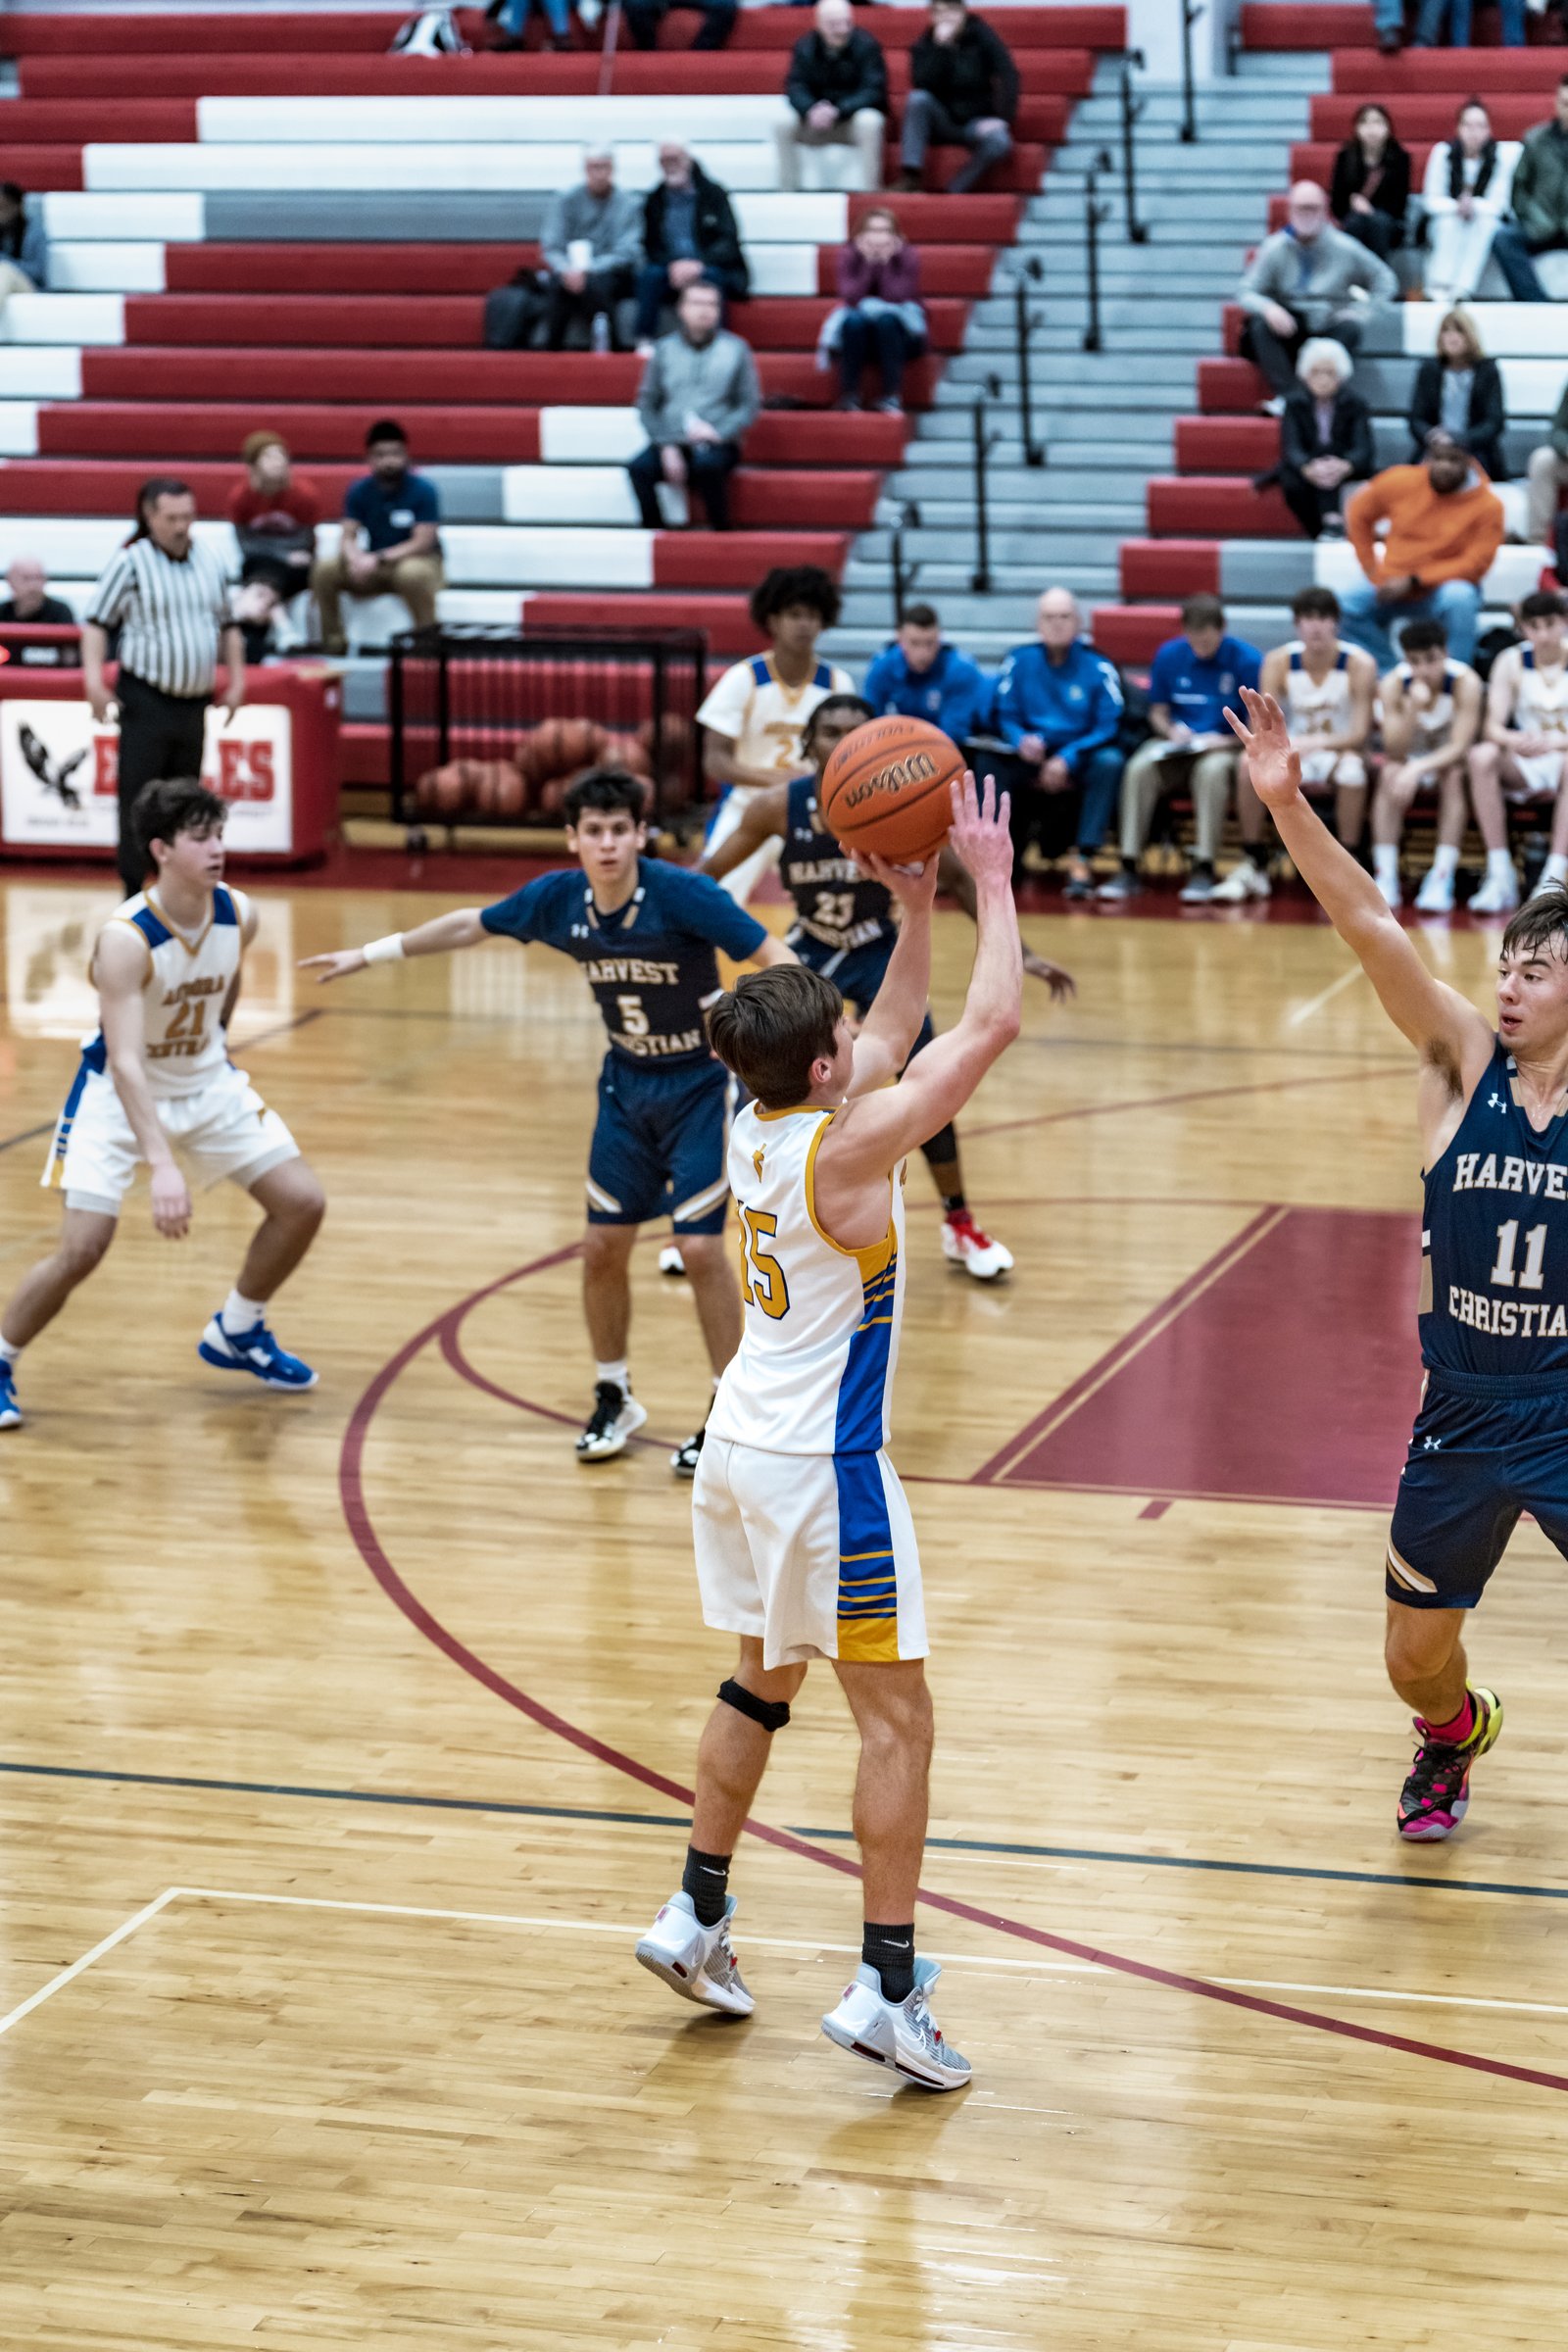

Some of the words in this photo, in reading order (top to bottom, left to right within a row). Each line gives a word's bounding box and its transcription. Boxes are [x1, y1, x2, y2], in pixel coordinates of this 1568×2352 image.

[93, 735, 275, 802] EES
[844, 753, 940, 808] Wilson
[813, 892, 856, 929] 23
[166, 998, 206, 1039] 21
[617, 995, 650, 1036] 5
[1452, 1153, 1568, 1200] HARVE
[736, 1200, 791, 1320] 15
[1490, 1219, 1547, 1290] 11
[1448, 1285, 1568, 1338] CHRISTIA
